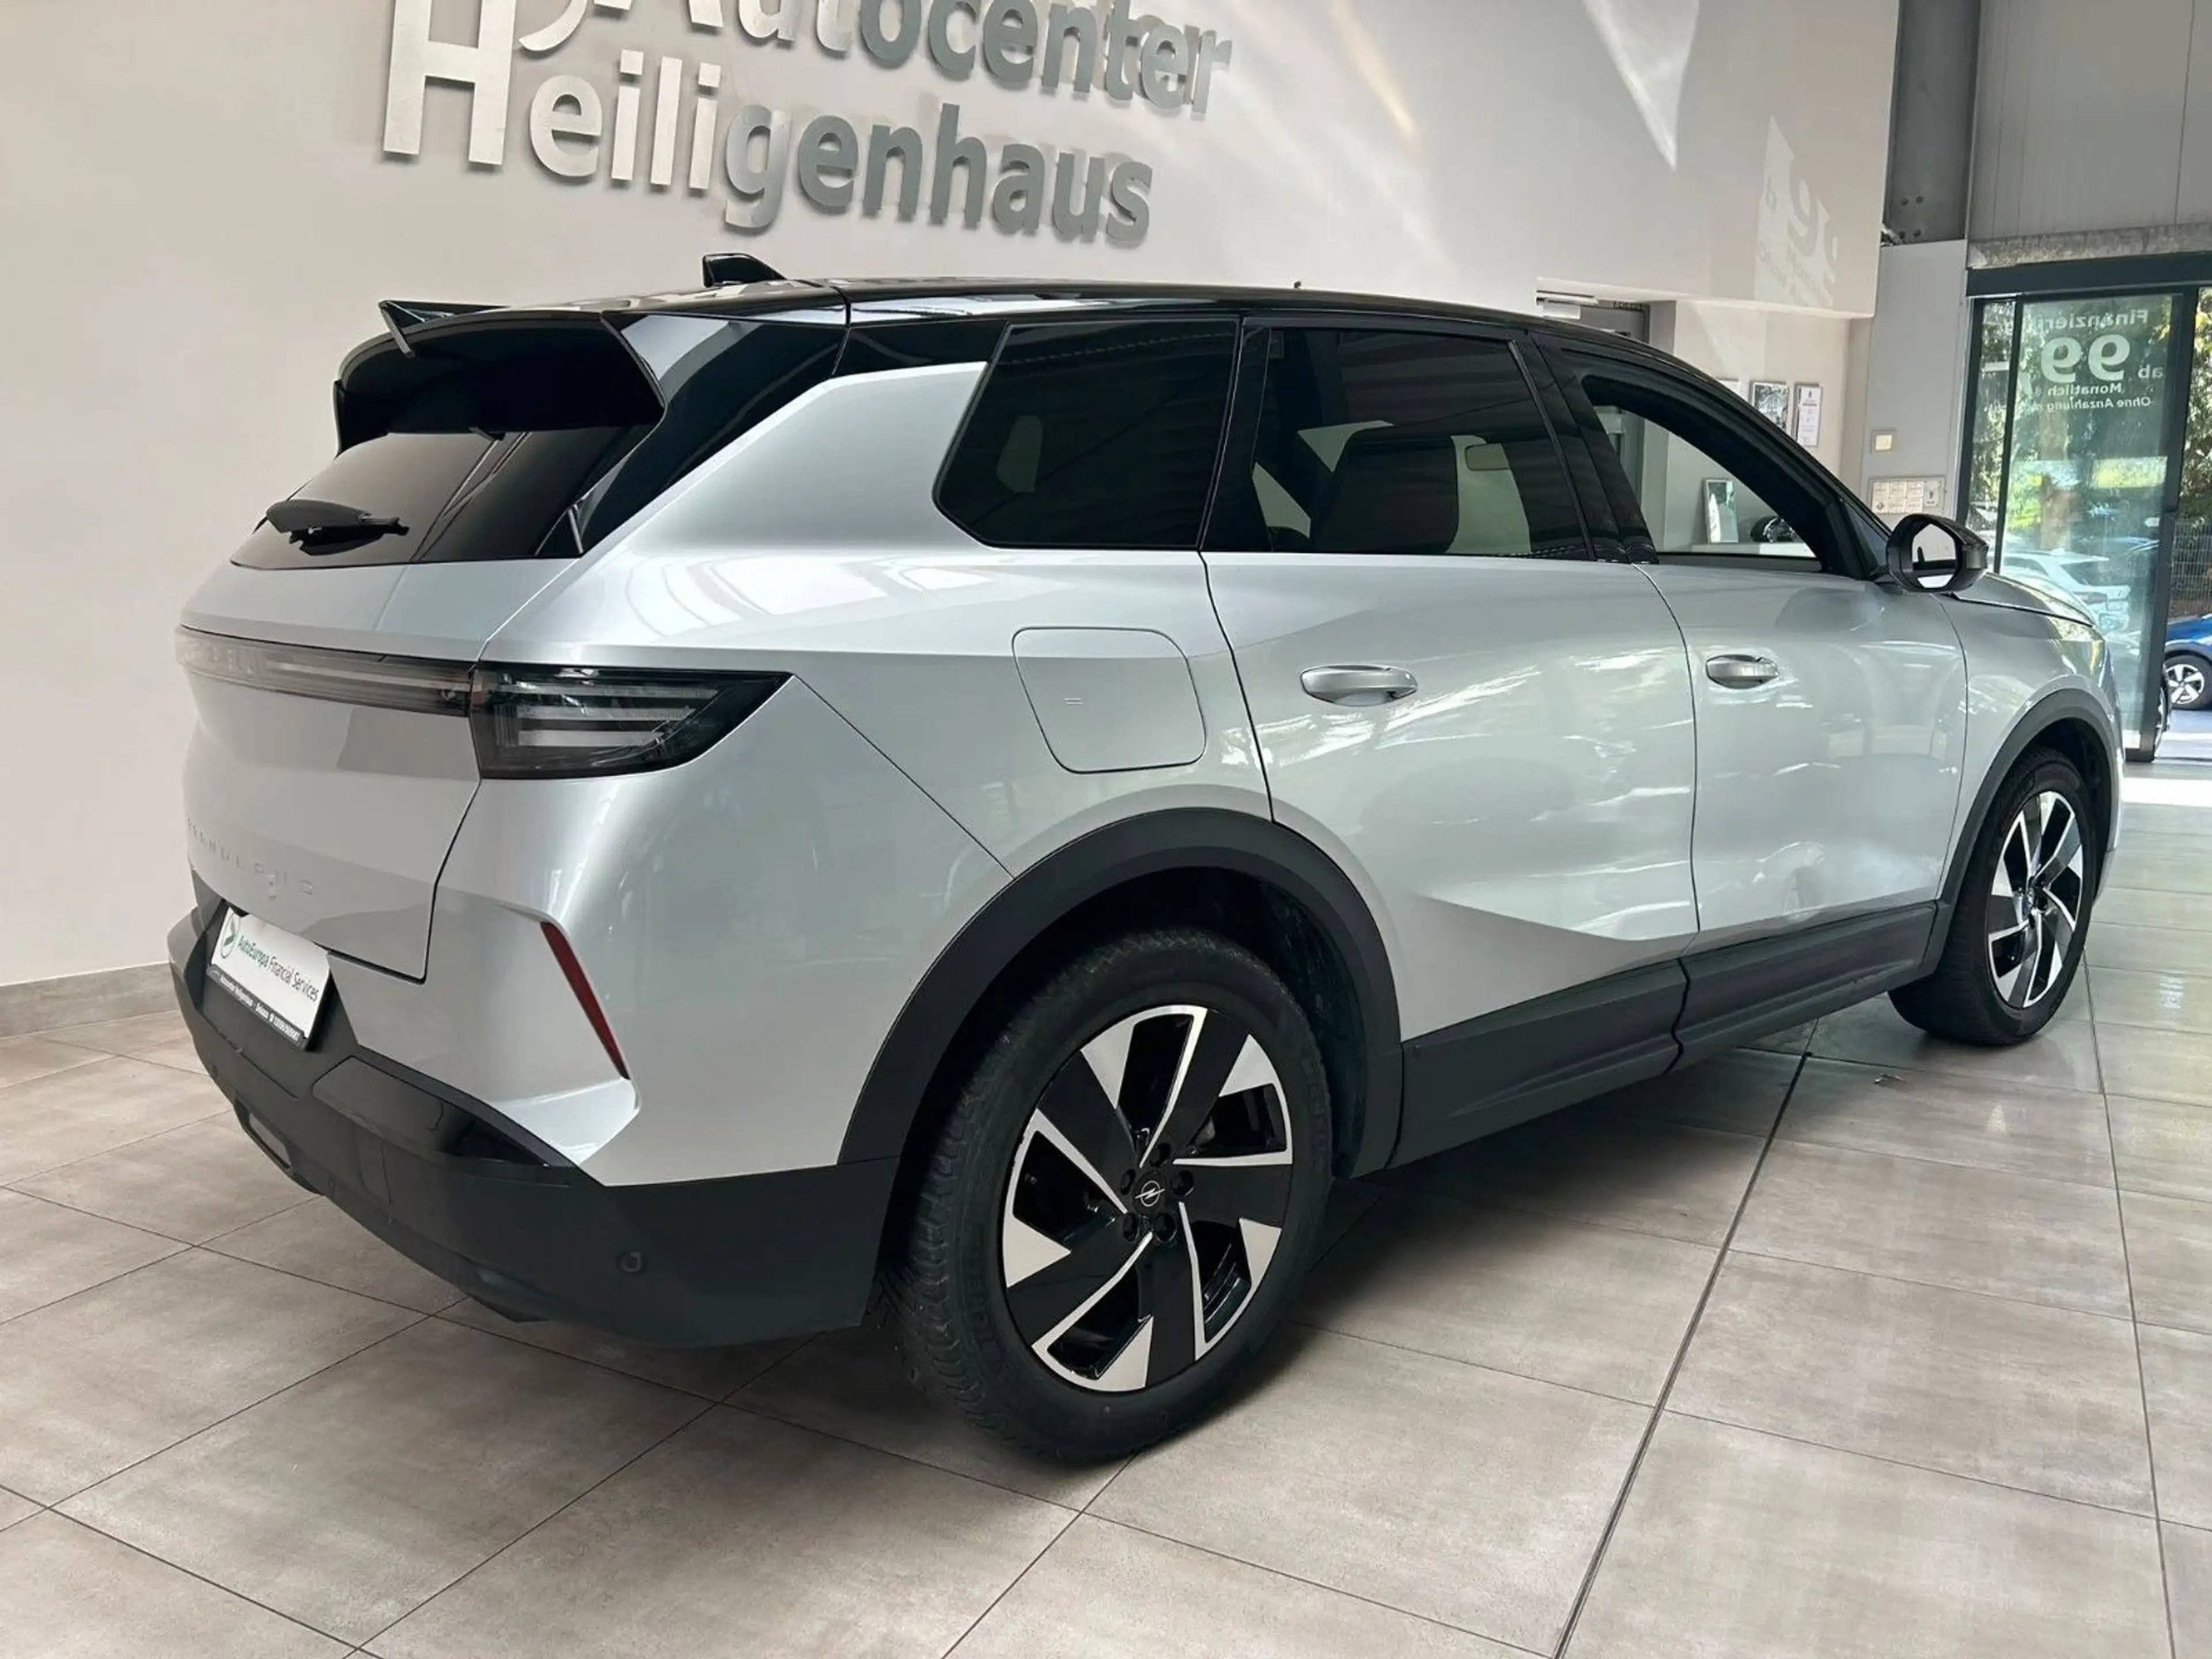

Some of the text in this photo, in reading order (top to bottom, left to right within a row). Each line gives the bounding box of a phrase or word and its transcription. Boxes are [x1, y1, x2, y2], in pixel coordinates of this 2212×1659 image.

[594, 0, 1232, 113] ocenter
[383, 0, 1152, 242] Heiligenhaus
[294, 972, 320, 1002] Services
